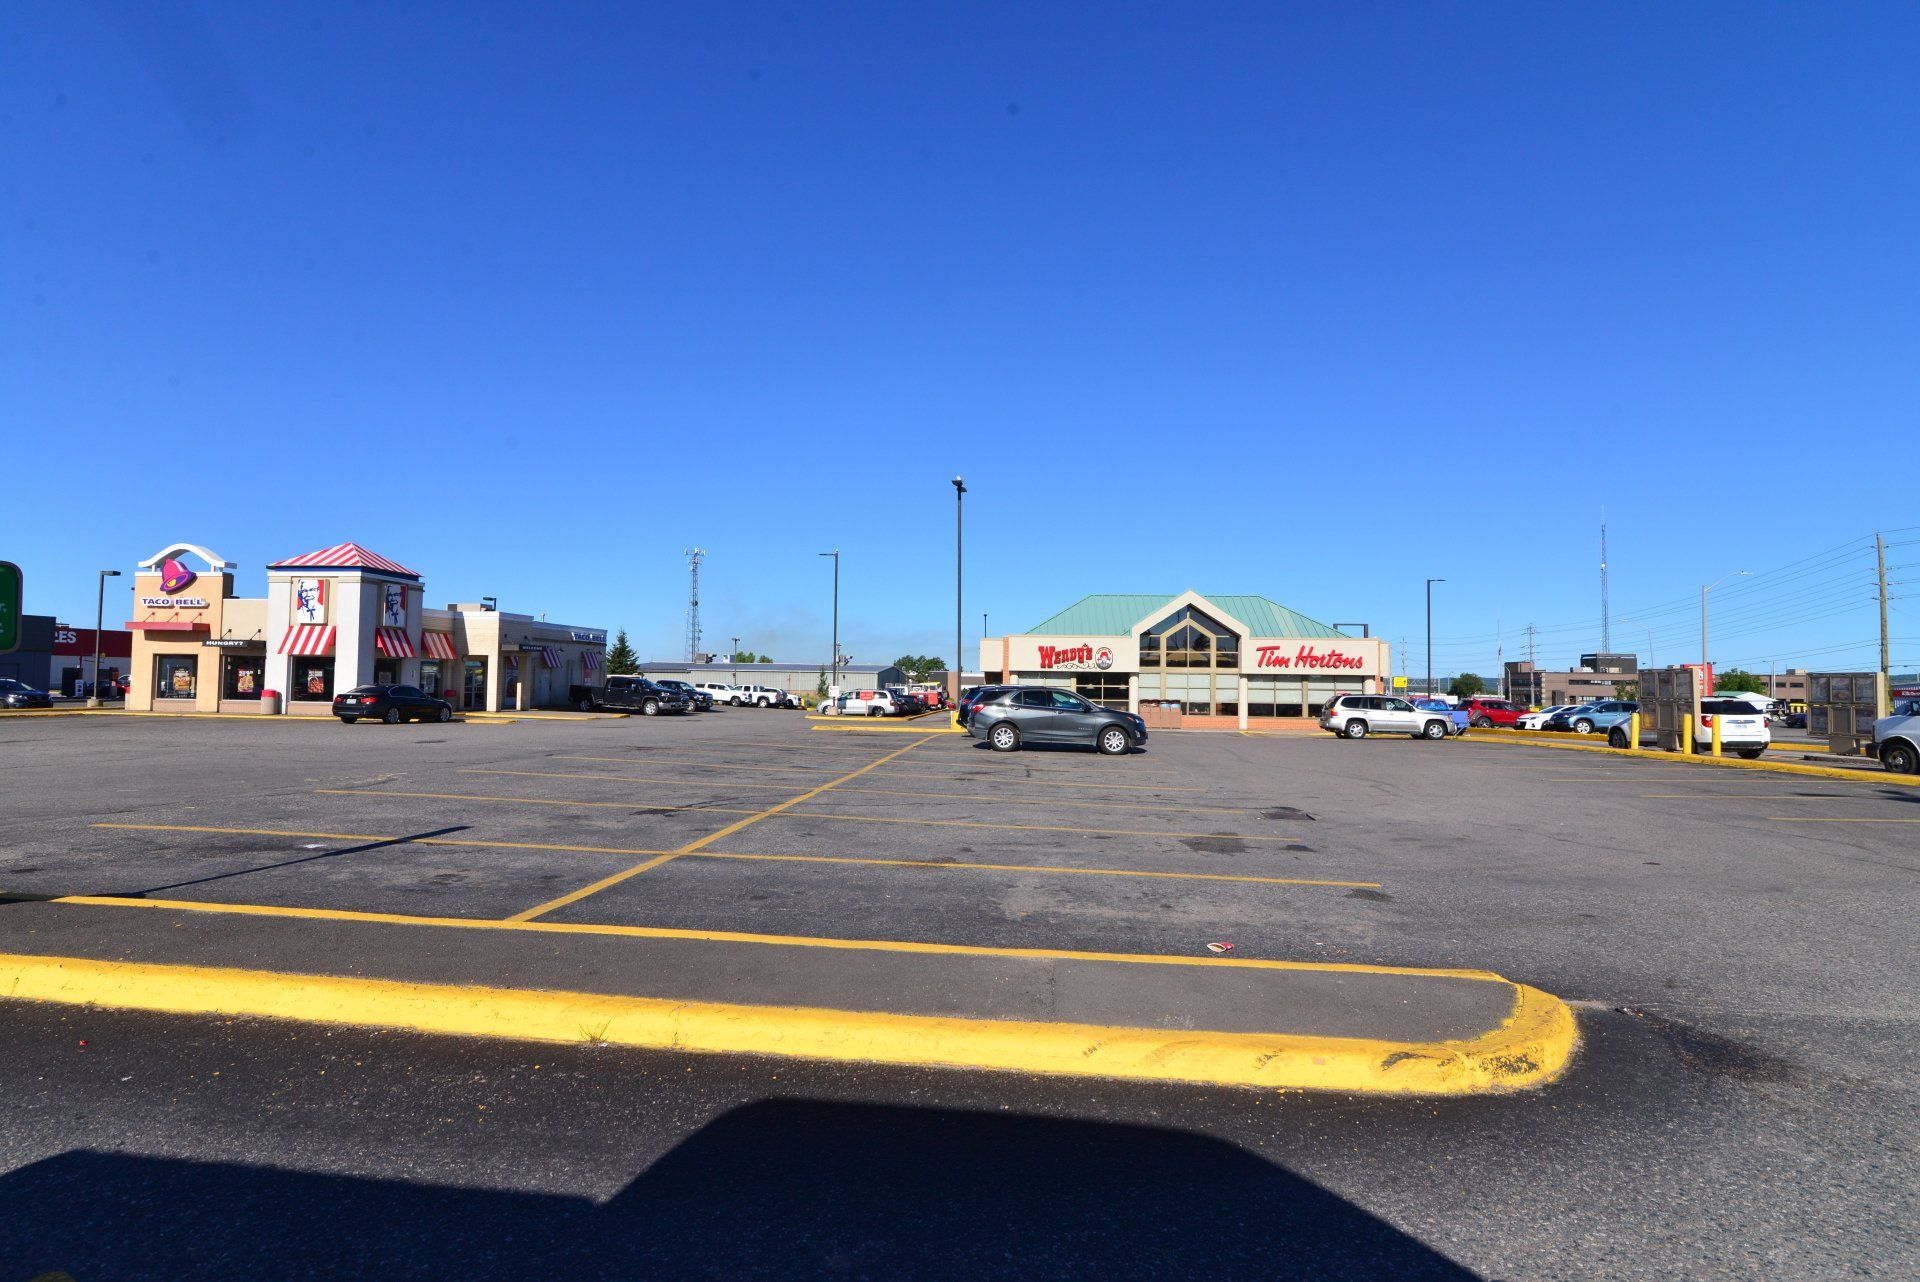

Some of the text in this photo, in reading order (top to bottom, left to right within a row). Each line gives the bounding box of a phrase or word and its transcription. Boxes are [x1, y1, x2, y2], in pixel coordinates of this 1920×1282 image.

[141, 598, 170, 606] TACO
[1256, 645, 1363, 669] Tim Hortons
